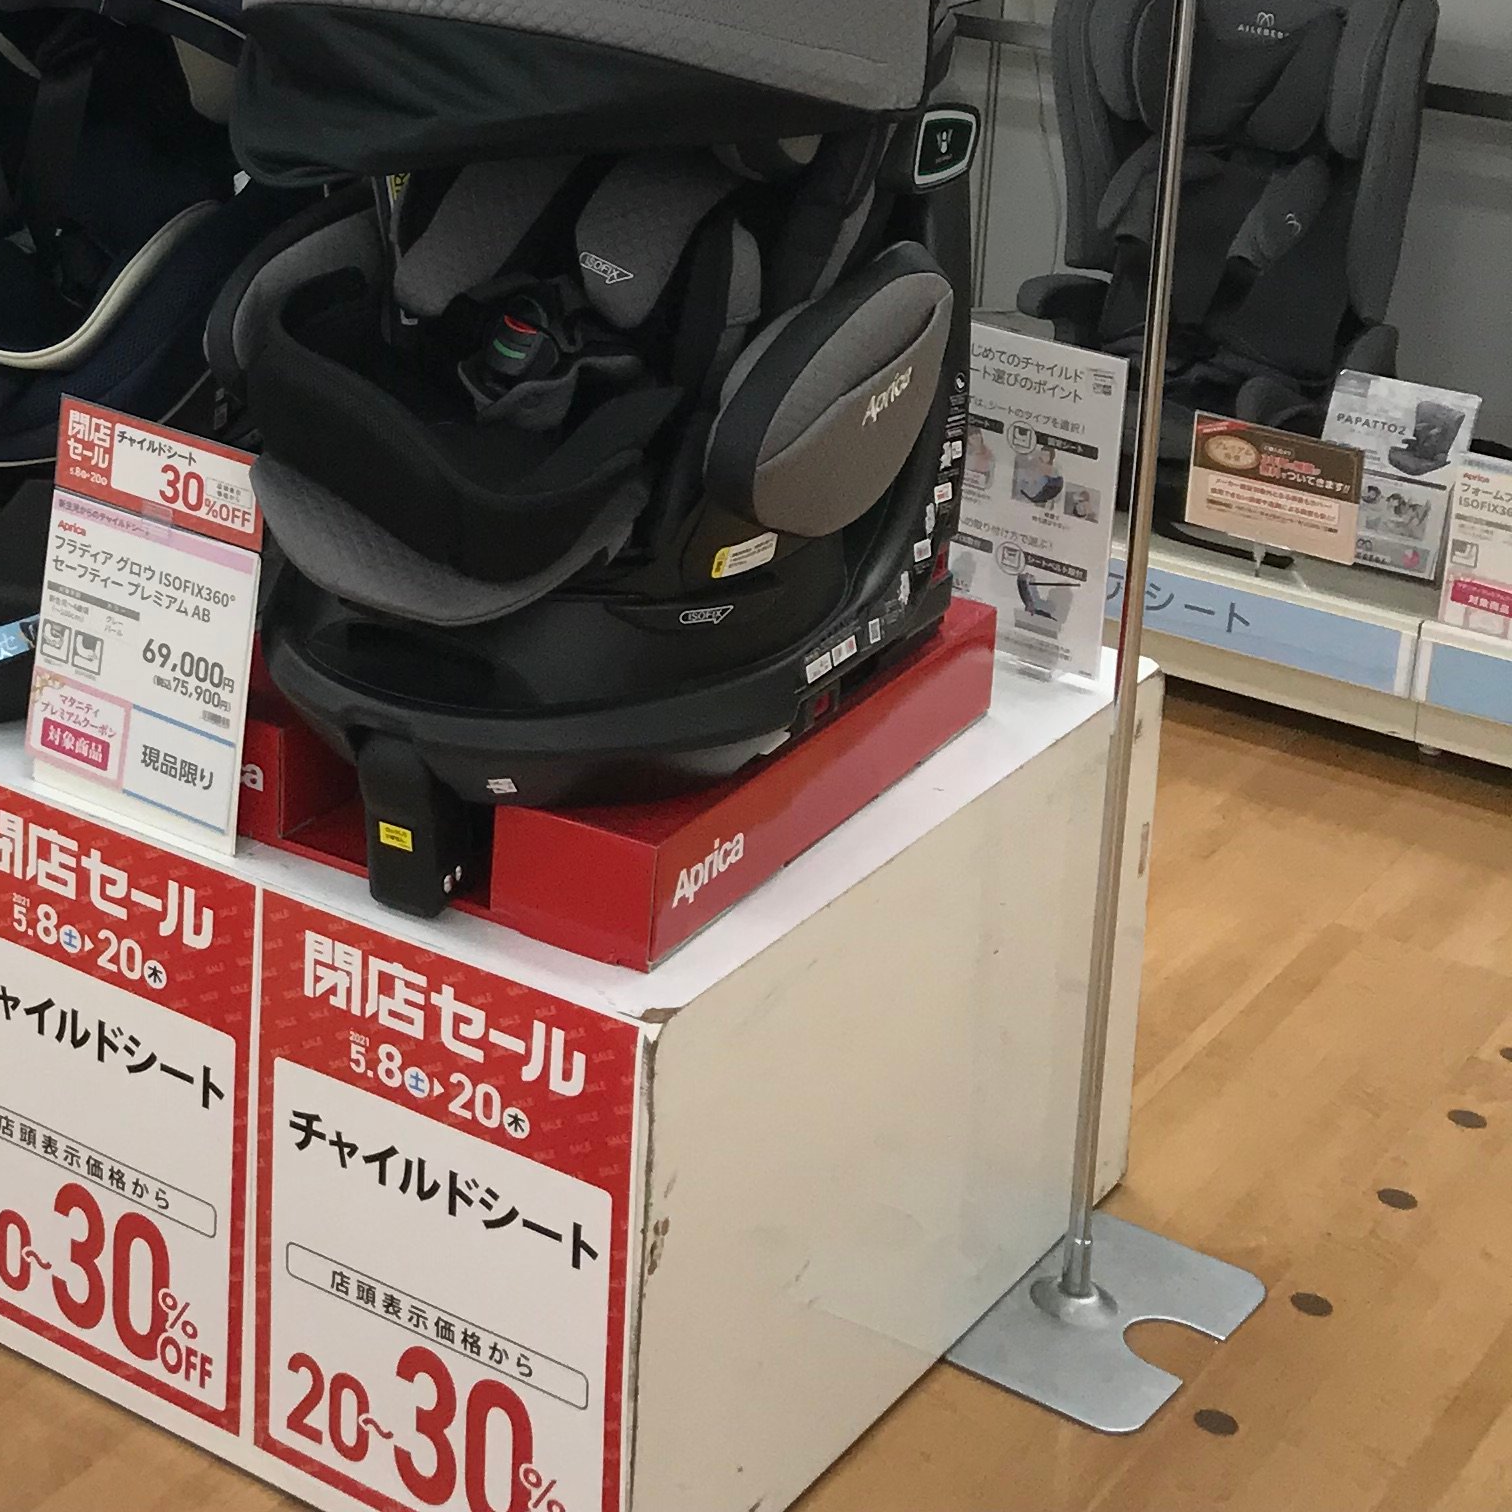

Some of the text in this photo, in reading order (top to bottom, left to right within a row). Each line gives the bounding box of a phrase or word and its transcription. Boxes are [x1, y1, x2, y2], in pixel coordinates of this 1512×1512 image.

[584, 254, 618, 280] ISOFIX
[861, 365, 913, 428] Aprica
[67, 408, 112, 448] 閉店
[1336, 412, 1408, 437] PAPATTO2
[67, 437, 109, 469] セール
[116, 430, 197, 467] チャイルドシート
[57, 519, 87, 537] Aprica
[54, 534, 114, 566] フラディア
[115, 554, 156, 582] グロウ
[52, 555, 124, 588] セーフティー
[126, 580, 190, 617] プレミアム
[191, 604, 211, 623] AB
[688, 610, 723, 621] ISOFIX
[141, 637, 235, 694] 69,000円
[39, 701, 118, 739] プレミアムクーポン
[58, 693, 100, 719] マタニティ
[47, 724, 104, 763] 対象商品
[140, 743, 215, 790] 現品限り
[672, 830, 745, 909] Aprica
[303, 929, 587, 1098] 閉店セール
[288, 1107, 600, 1270] チャイルドシート
[329, 1269, 535, 1381] 店頭表示価格から
